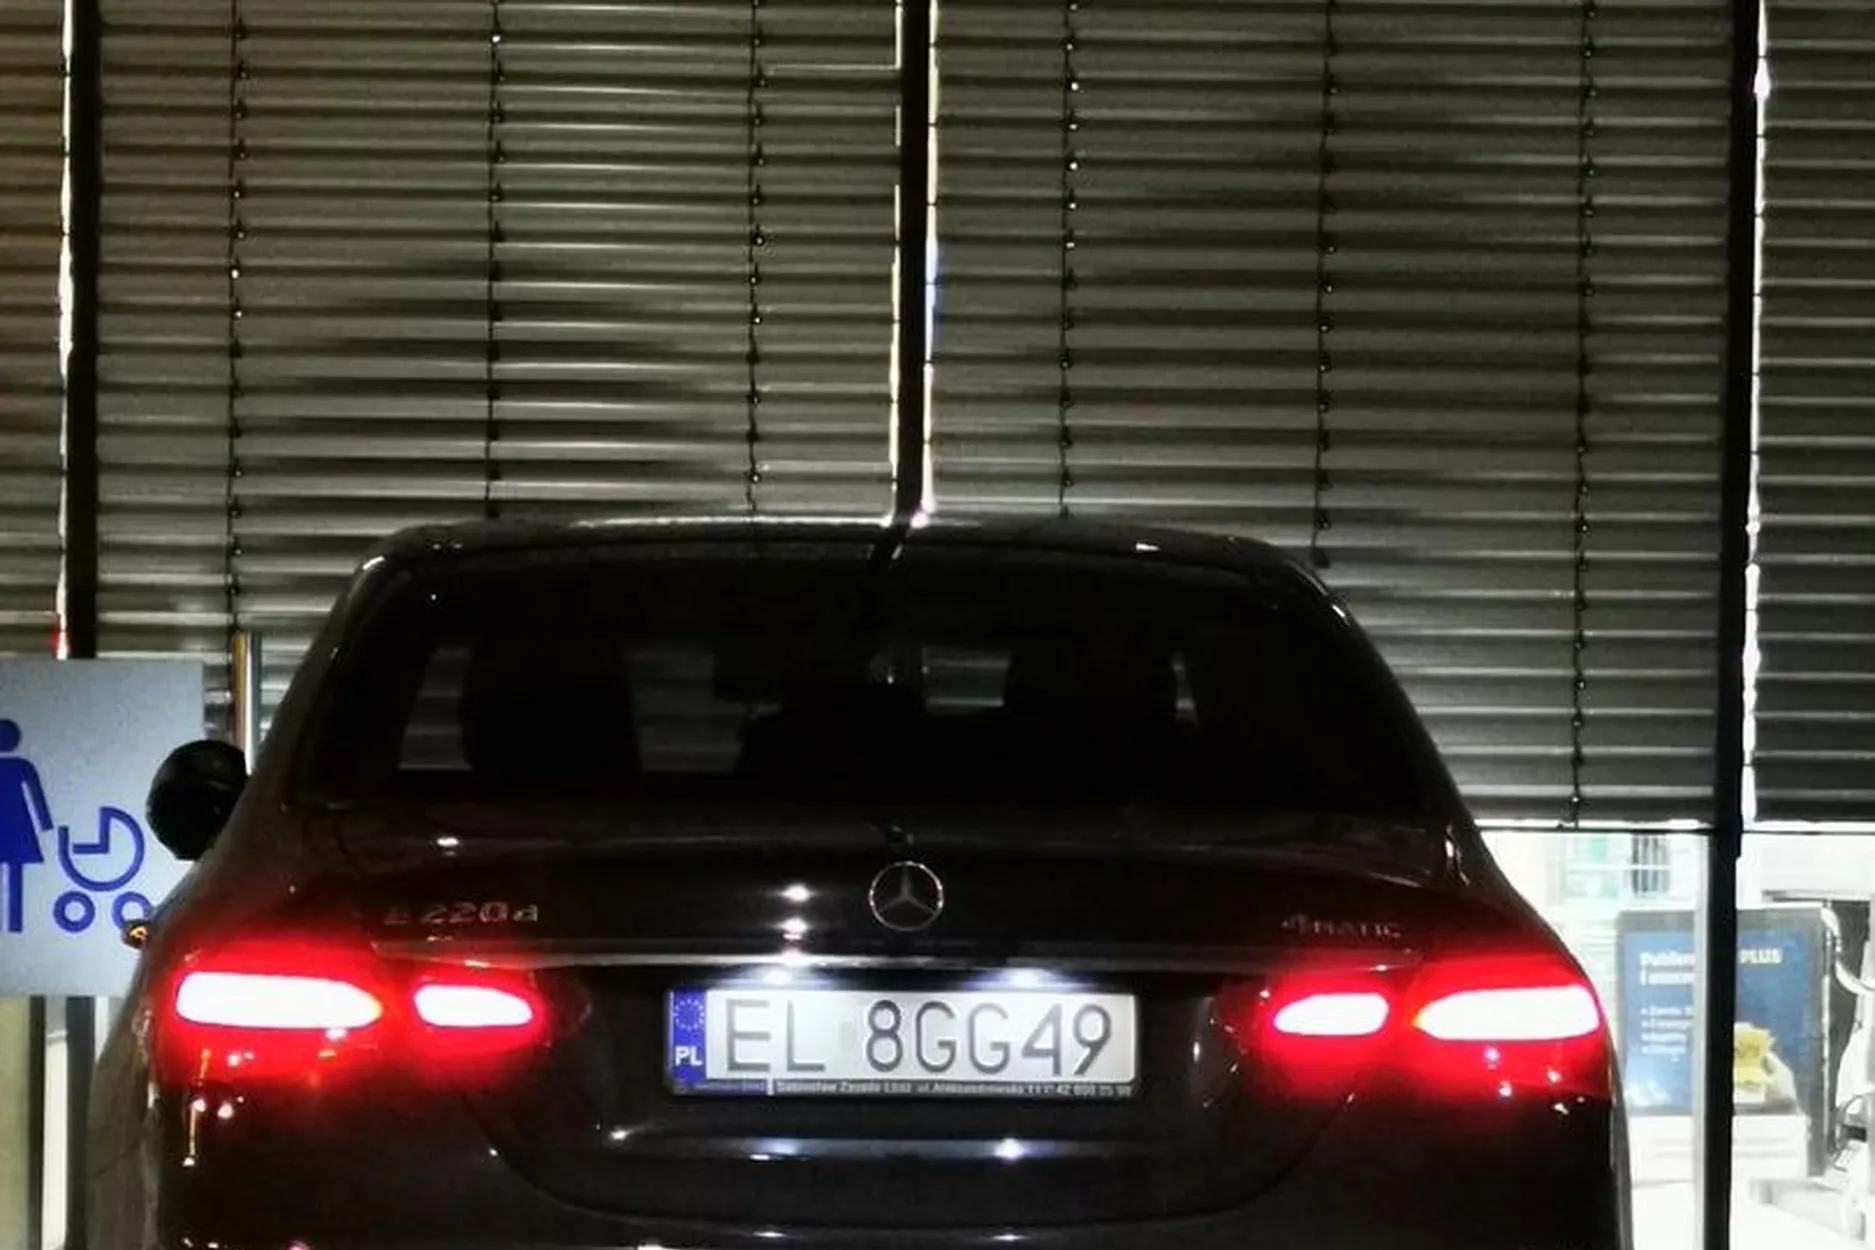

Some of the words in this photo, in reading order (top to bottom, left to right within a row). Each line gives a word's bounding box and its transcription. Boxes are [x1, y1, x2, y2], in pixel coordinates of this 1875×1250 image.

[675, 1046, 703, 1066] PL
[726, 999, 826, 1073] EL
[866, 999, 1112, 1077] 8GG49
